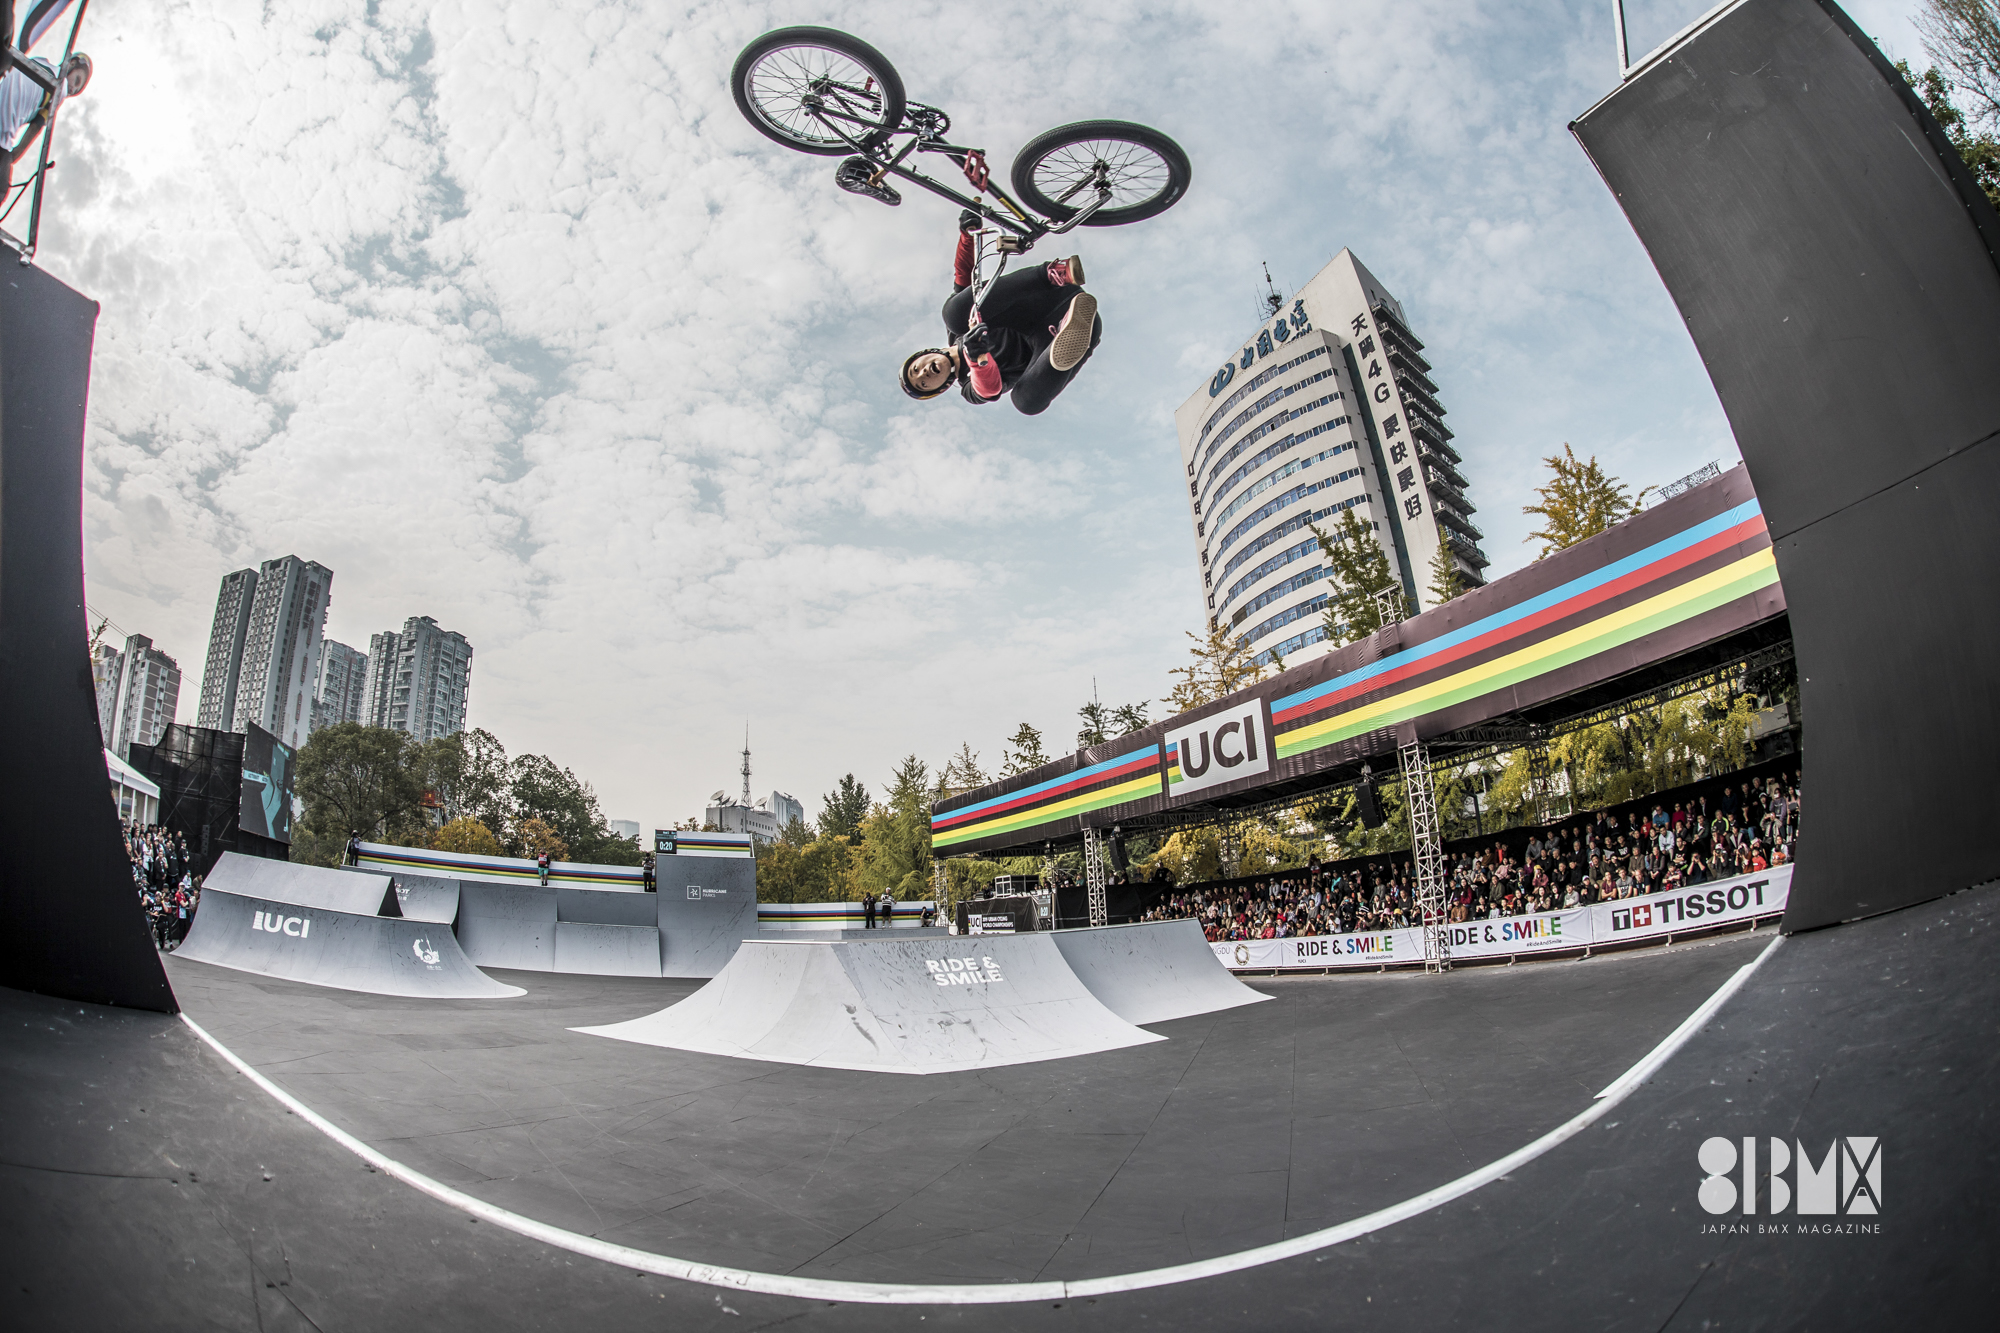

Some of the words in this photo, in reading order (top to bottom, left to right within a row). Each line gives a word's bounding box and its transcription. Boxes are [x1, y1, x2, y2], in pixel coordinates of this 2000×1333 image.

[1240, 299, 1308, 370] 中国电信
[1181, 714, 1258, 778] UCI
[660, 841, 673, 850] 0:20
[1654, 879, 1770, 924] TISSOT
[262, 912, 310, 938] UCI
[970, 917, 982, 928] UCI
[1484, 925, 1497, 943] &
[1502, 916, 1562, 941] SMILE
[1297, 940, 1328, 957] RIDE
[1332, 939, 1343, 955] &
[1346, 935, 1393, 954] SMILE
[1526, 938, 1562, 947] #RideAndSmile
[925, 957, 979, 973] RIDE
[982, 956, 1000, 969] &
[934, 969, 1004, 986] SMILE
